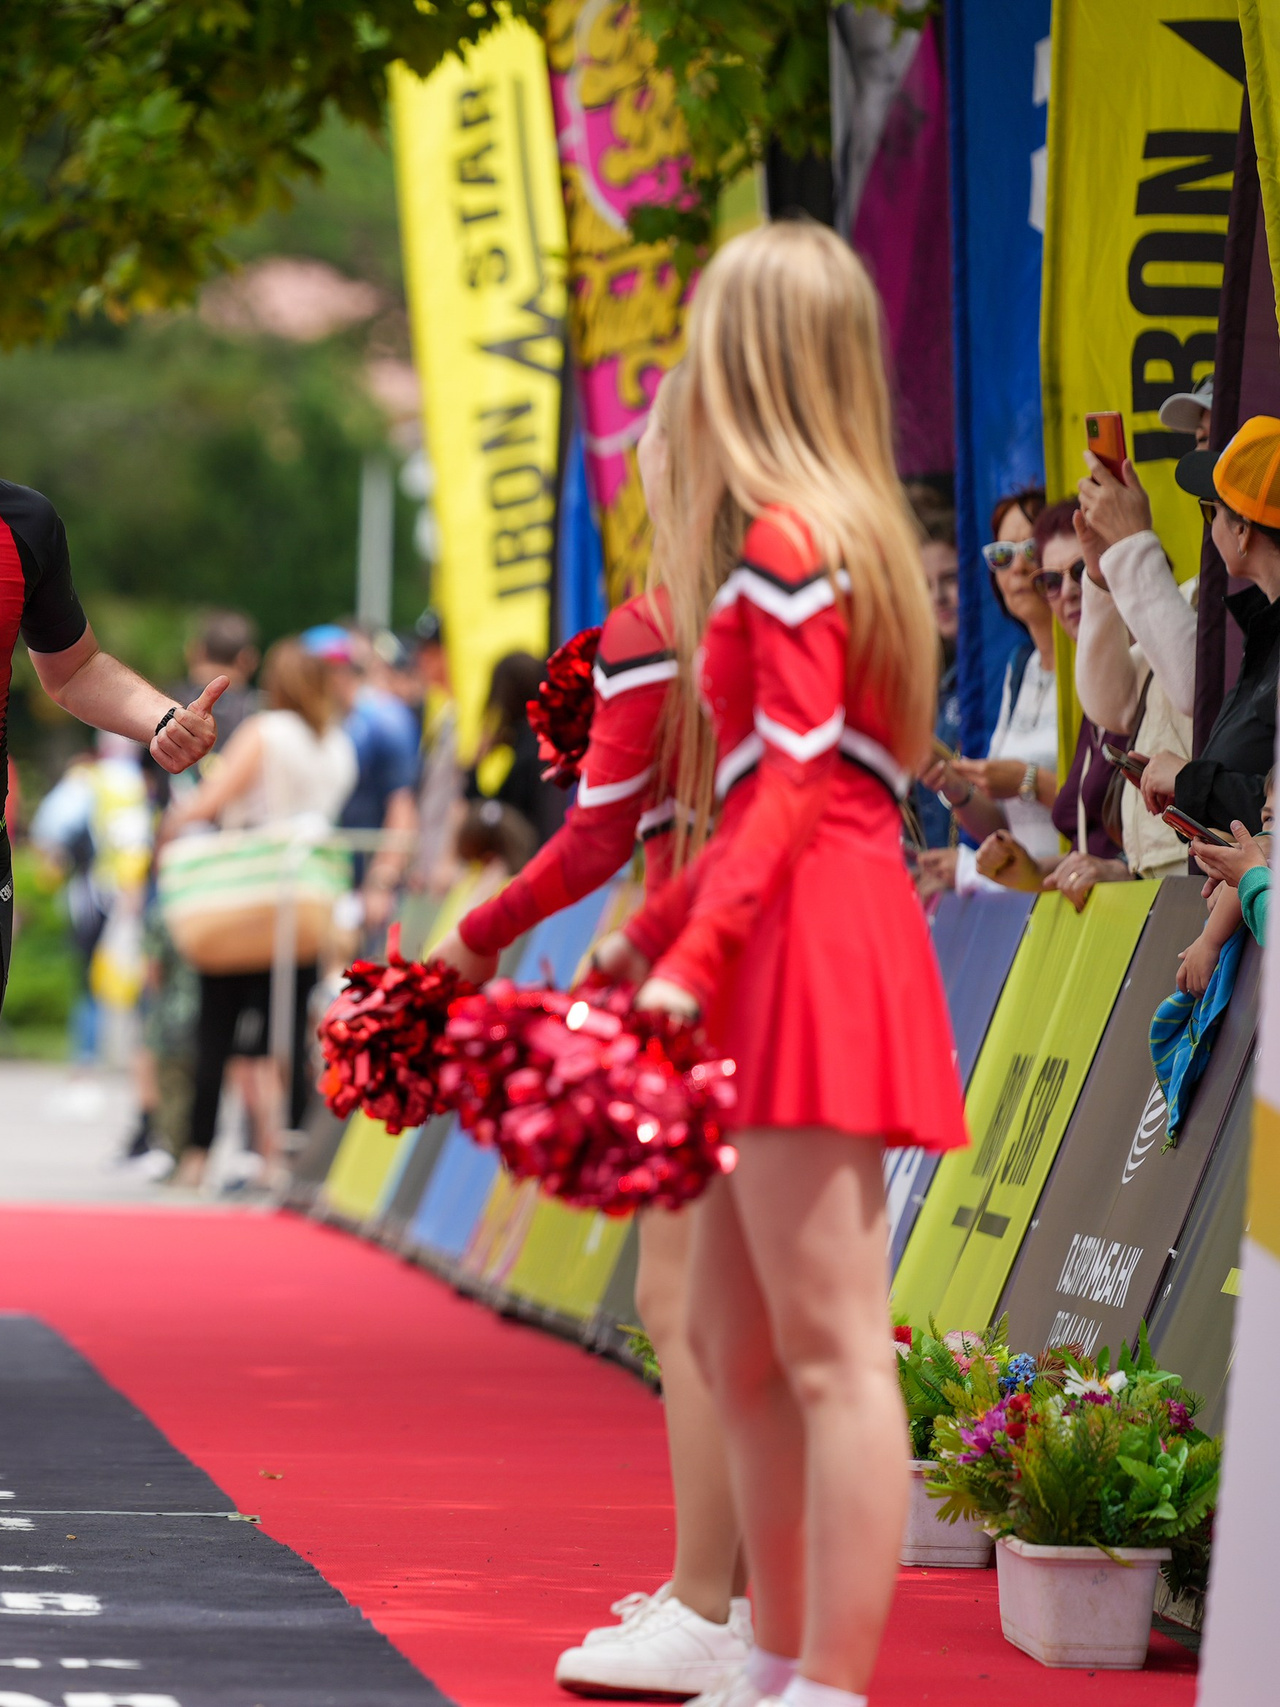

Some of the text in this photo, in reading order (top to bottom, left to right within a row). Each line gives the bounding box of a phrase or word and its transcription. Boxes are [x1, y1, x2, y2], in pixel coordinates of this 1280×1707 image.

[456, 80, 554, 600] IRON STAR
[1000, 1054, 1070, 1187] STAR
[1055, 1232, 1144, 1309] ГАЗПРОМБАНК
